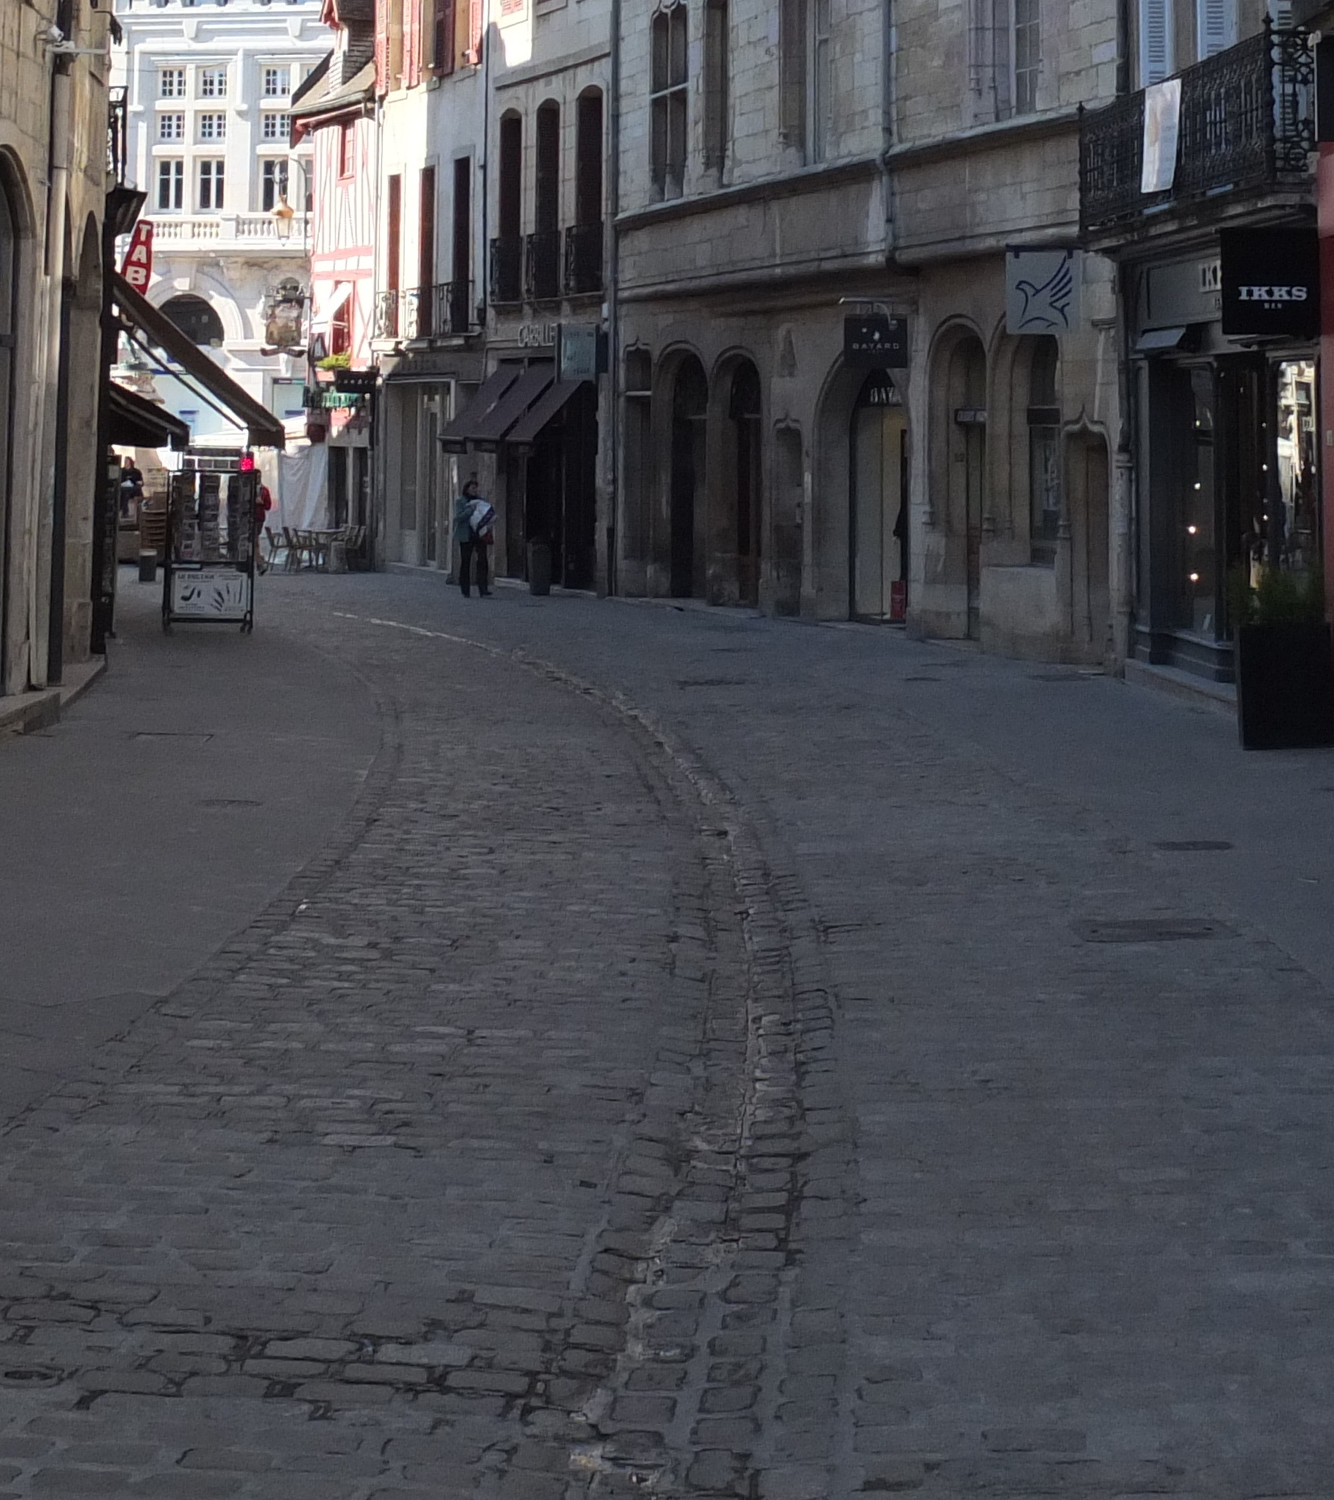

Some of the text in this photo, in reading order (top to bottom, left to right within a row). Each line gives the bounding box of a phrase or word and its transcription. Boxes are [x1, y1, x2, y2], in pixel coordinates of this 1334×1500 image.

[125, 223, 152, 285] TAB
[1237, 286, 1307, 301] IKKS
[852, 342, 900, 350] BAYARD
